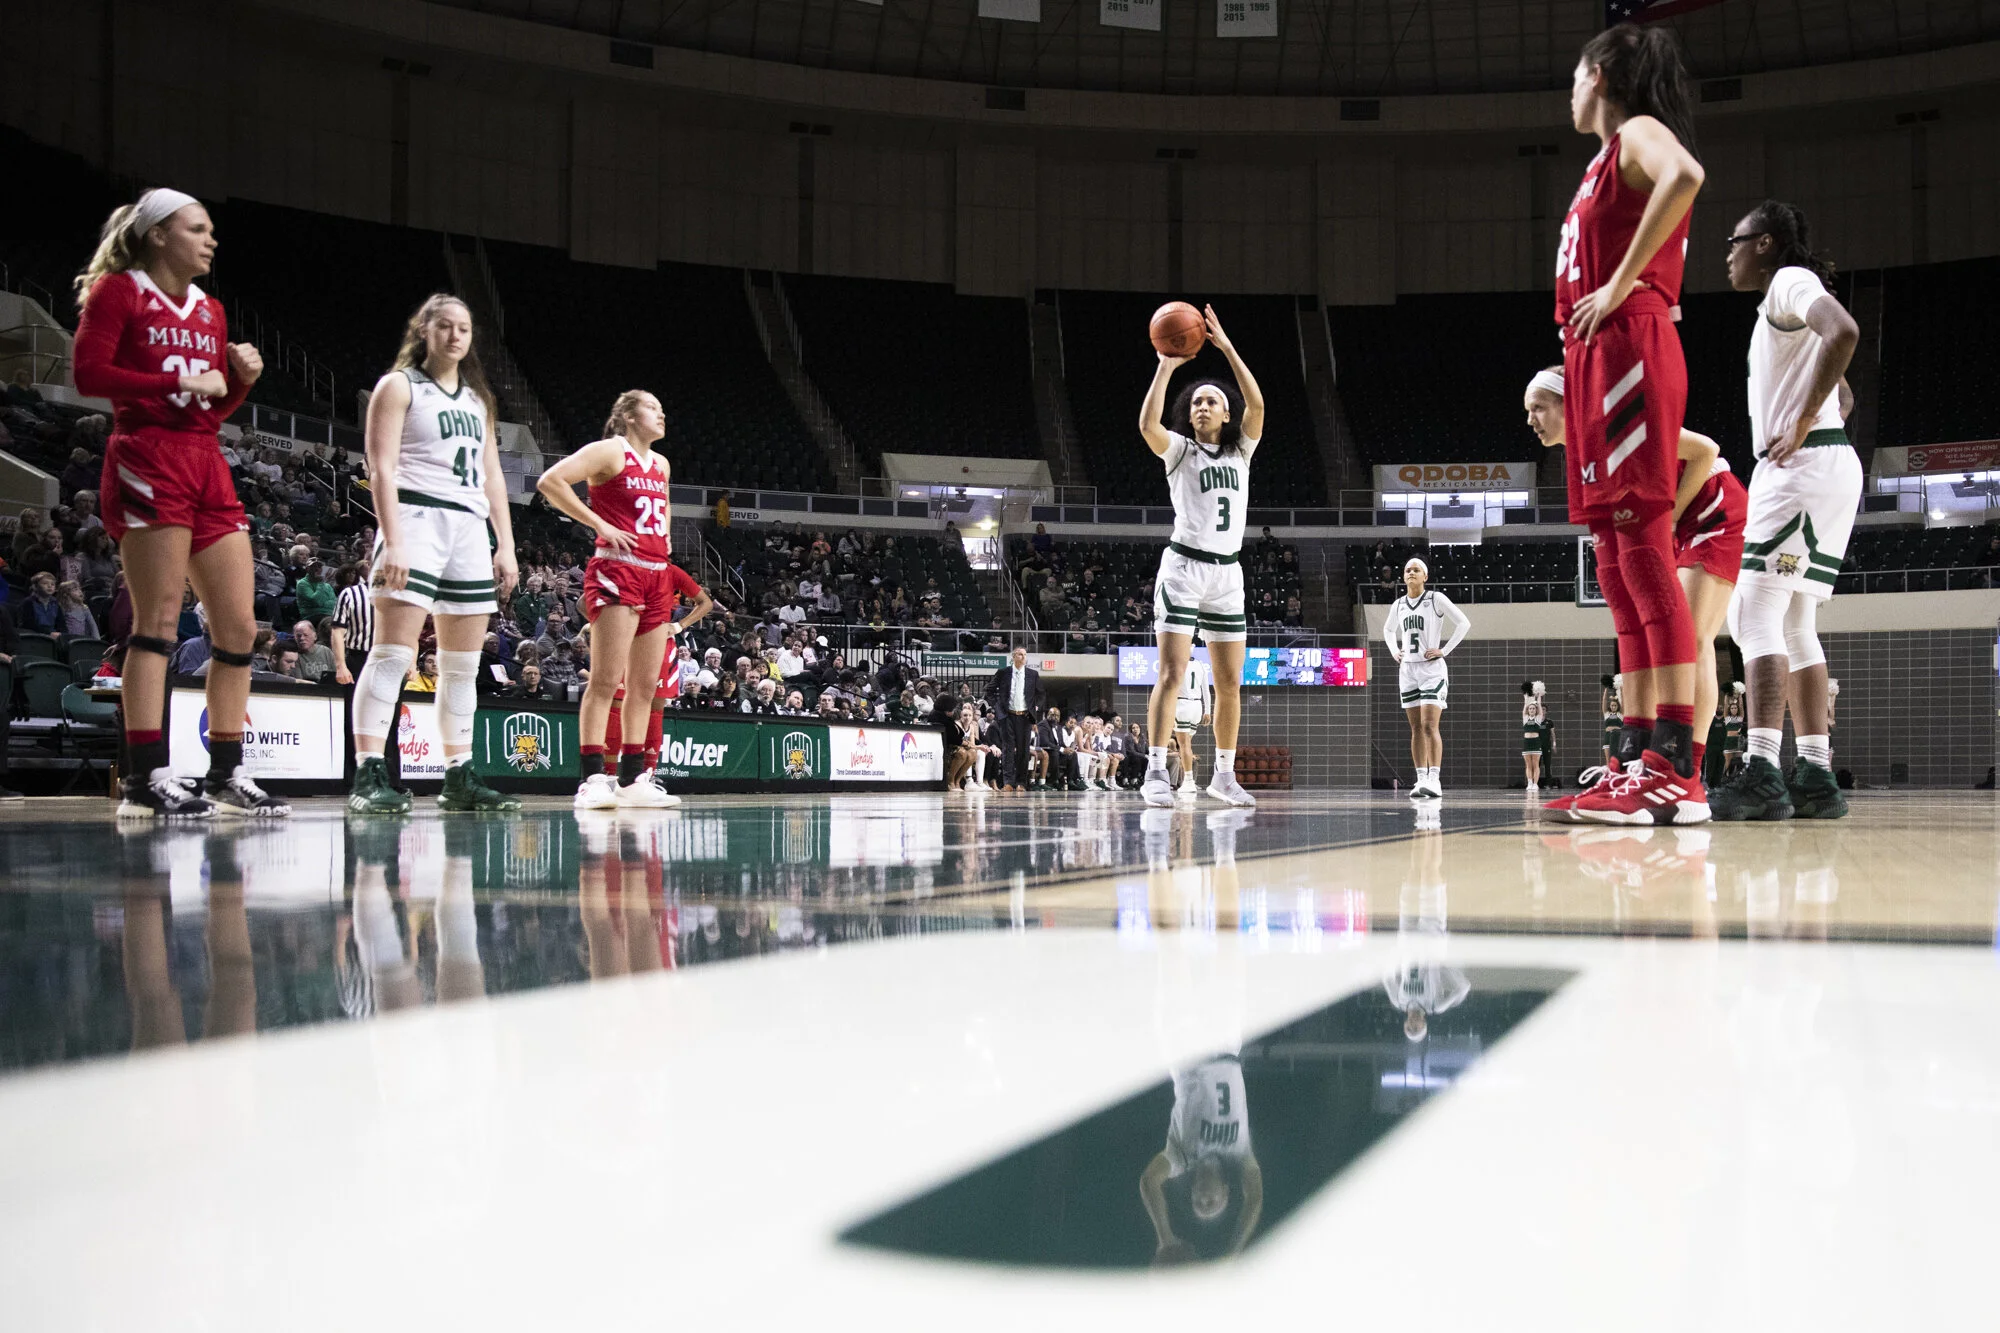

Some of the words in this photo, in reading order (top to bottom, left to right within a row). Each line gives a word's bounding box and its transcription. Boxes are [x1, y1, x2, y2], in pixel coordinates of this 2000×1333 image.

[1223, 13, 1245, 21] 2015
[147, 326, 217, 355] MIAMI
[438, 409, 482, 443] OHIO
[256, 433, 293, 450] SERVED
[453, 447, 478, 488] 41
[1399, 465, 1511, 487] QDOBA
[1200, 465, 1240, 494] OHIO
[635, 495, 666, 538] 25
[1216, 496, 1231, 532] 3
[1403, 614, 1425, 632] OHIO
[1410, 632, 1420, 654] 5
[1290, 648, 1322, 668] 7:10
[1257, 660, 1269, 679] 4
[1345, 661, 1354, 680] 1
[1191, 671, 1196, 689] 1
[258, 731, 300, 745] WHITE
[260, 749, 276, 759] INC.
[398, 734, 430, 762] ndy's
[657, 734, 729, 767] Holzer
[919, 752, 933, 760] WHITE
[403, 764, 424, 773] Athens
[654, 766, 669, 776] ealth
